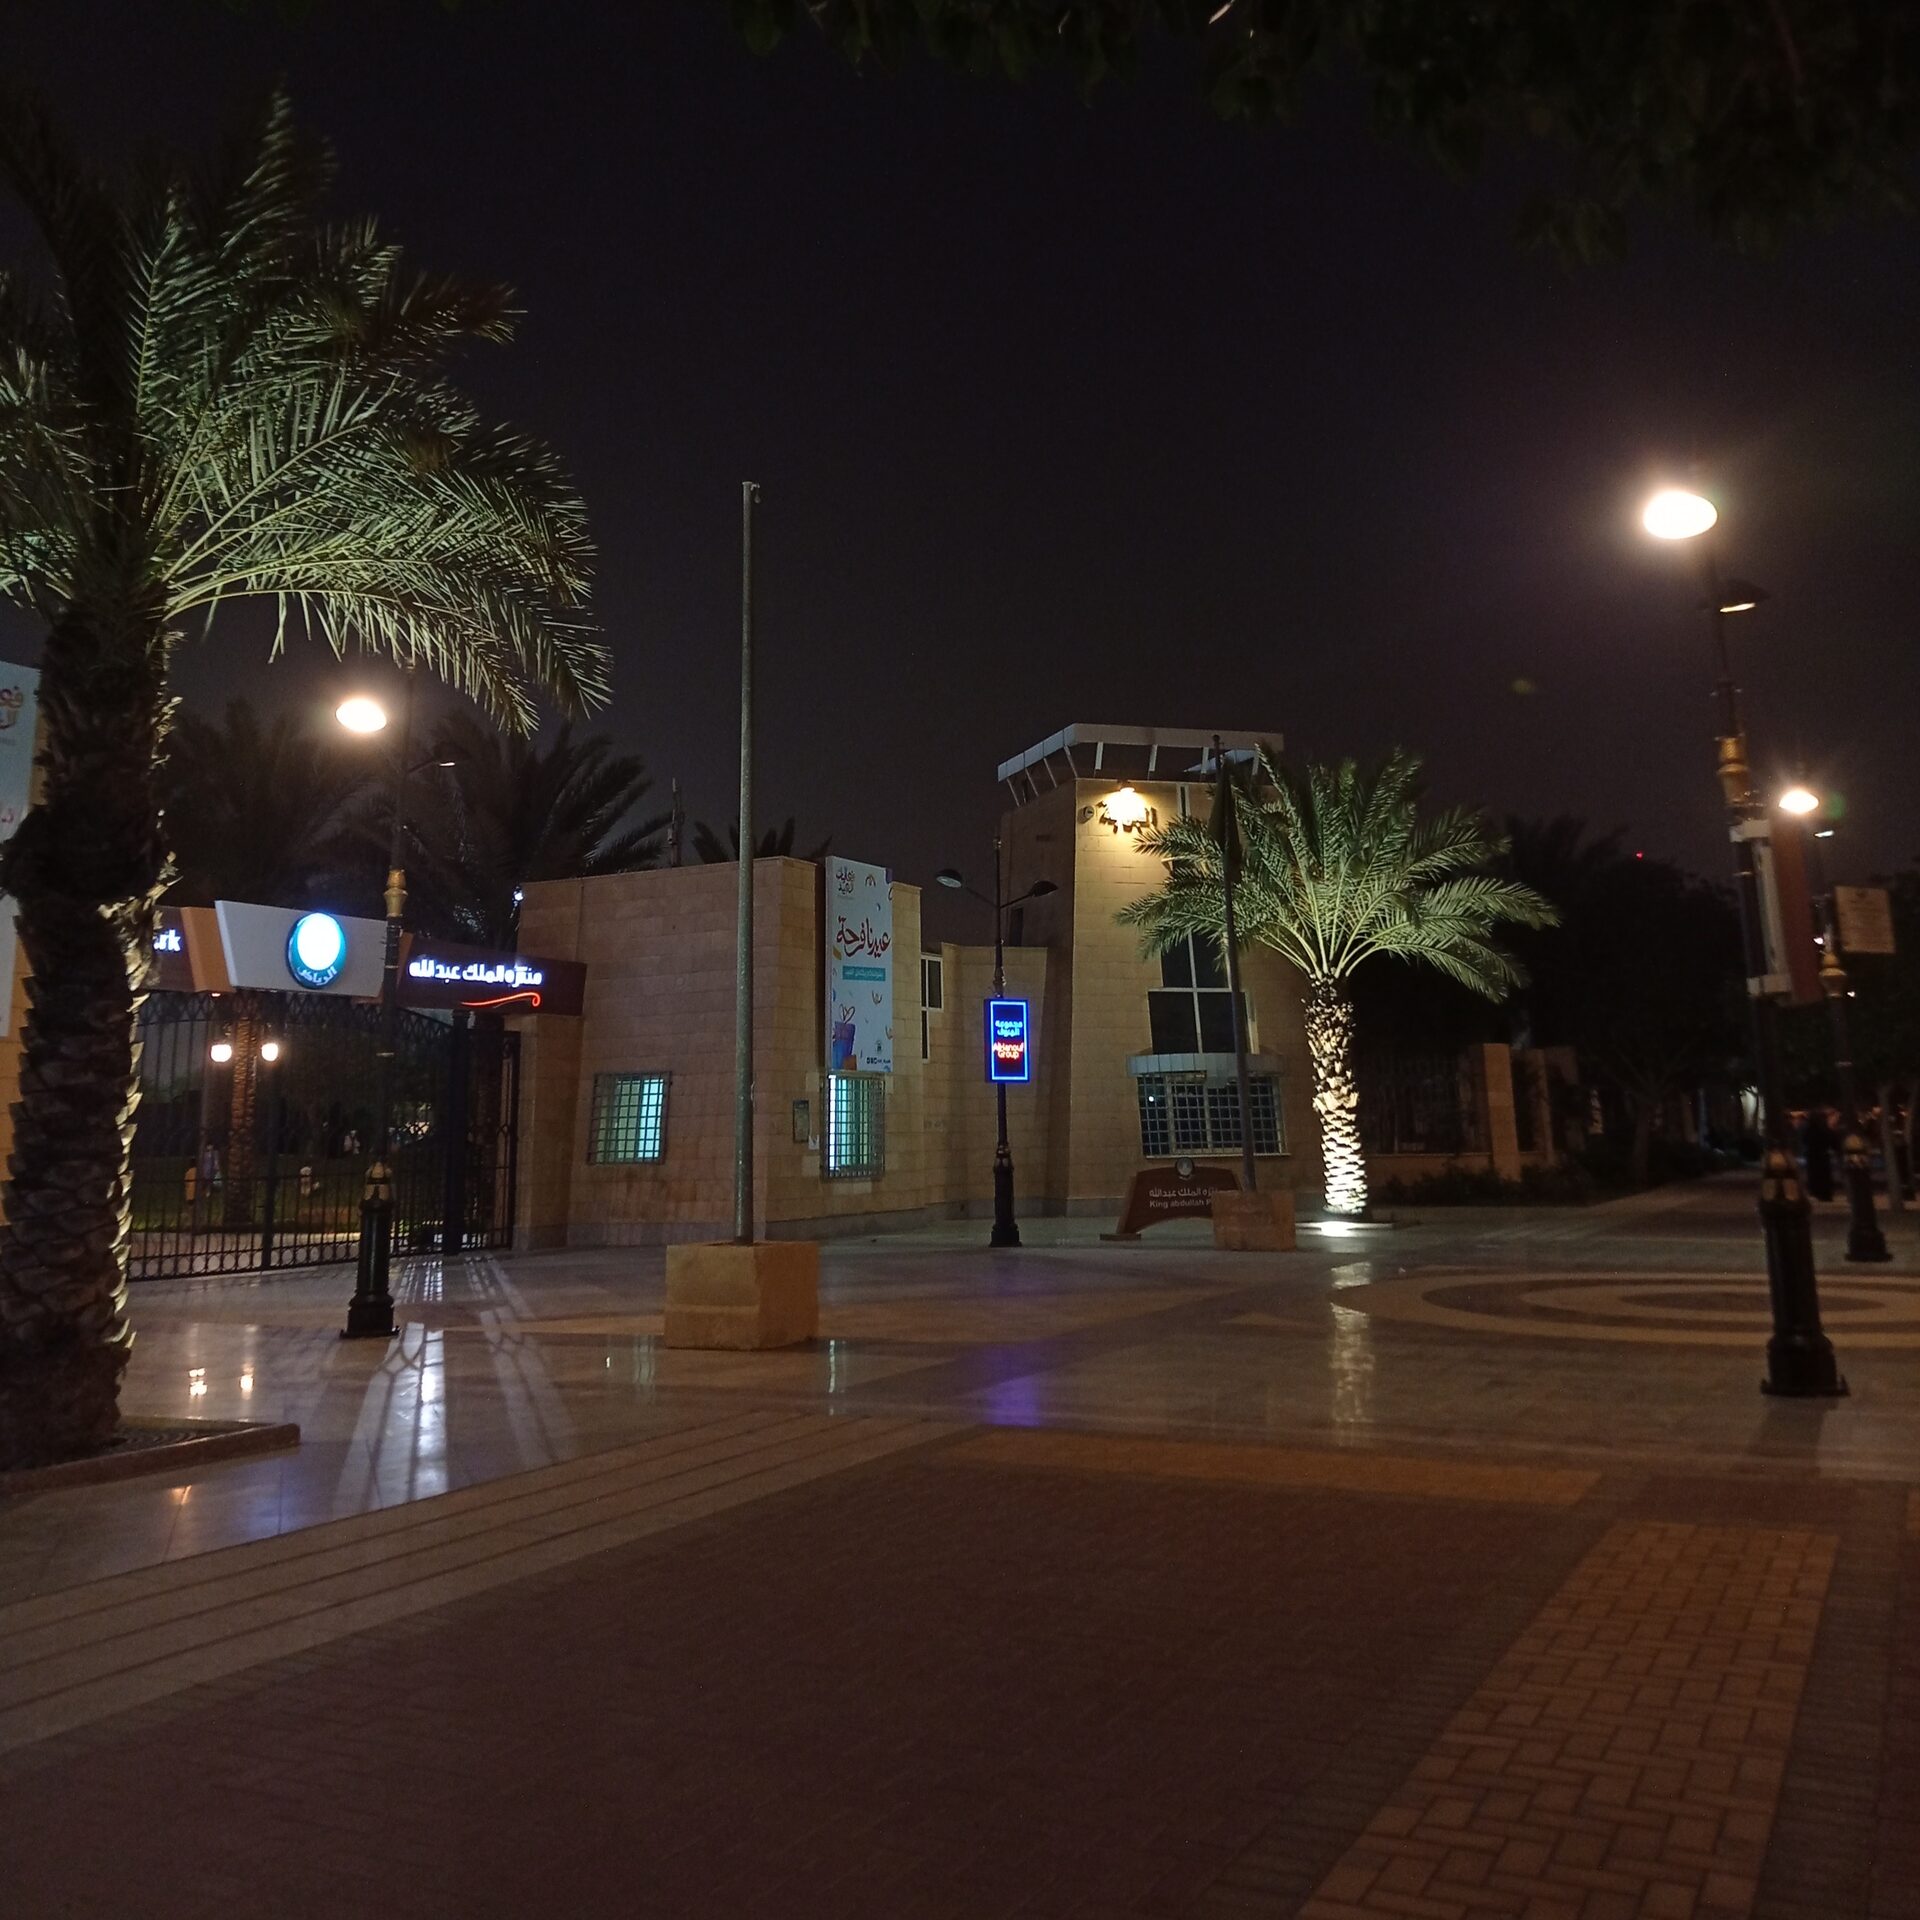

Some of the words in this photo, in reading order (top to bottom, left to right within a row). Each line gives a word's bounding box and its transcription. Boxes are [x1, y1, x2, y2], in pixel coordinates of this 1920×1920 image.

[462, 963, 505, 983] الملك
[998, 1051, 1019, 1059] Group
[1177, 1187, 1201, 1197] الملك
[1149, 1199, 1168, 1209] King
